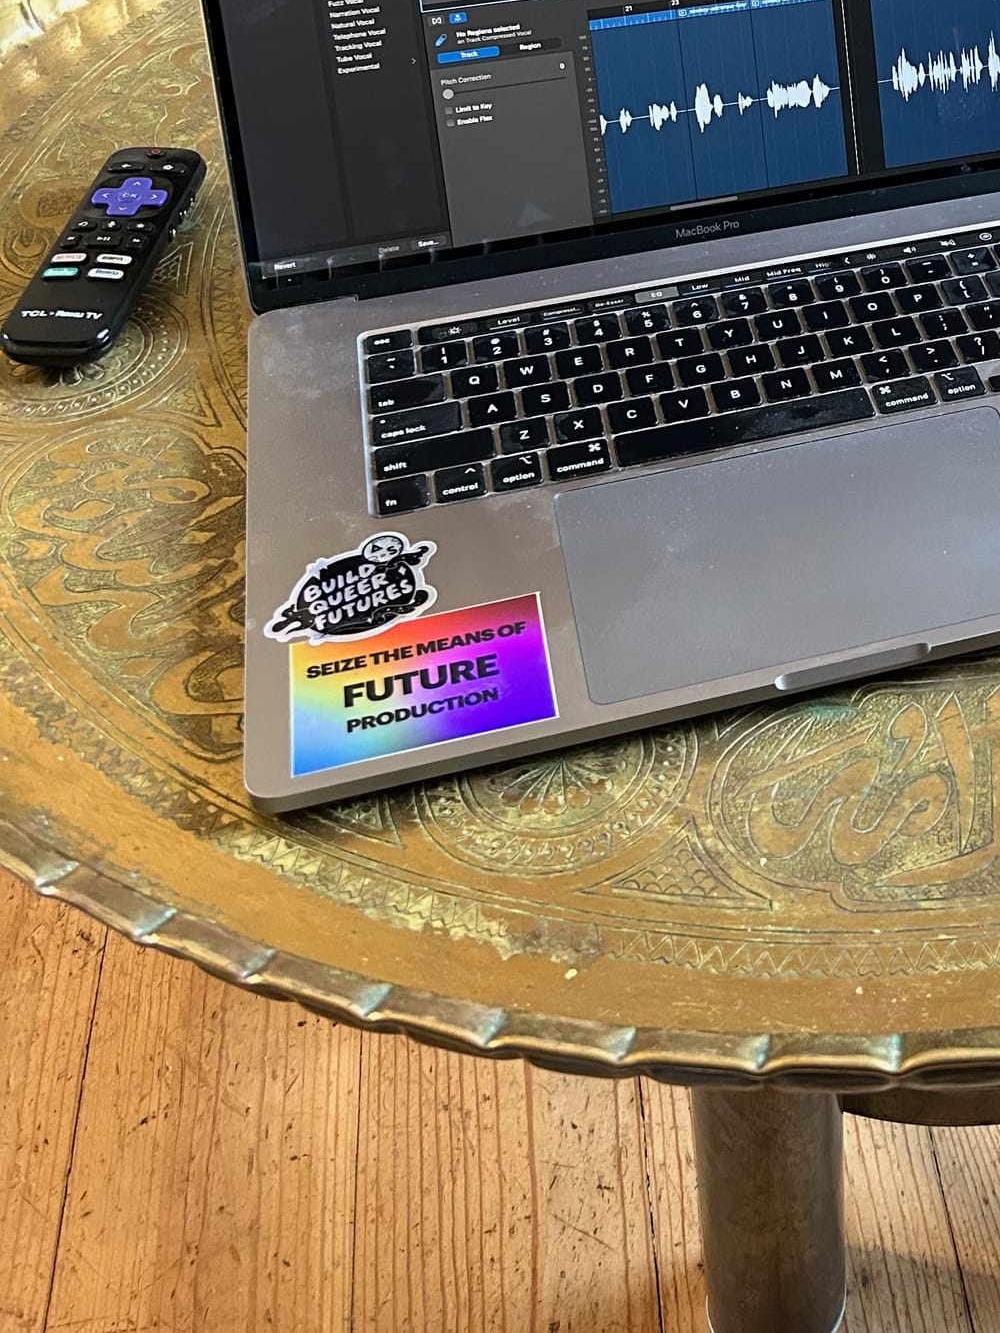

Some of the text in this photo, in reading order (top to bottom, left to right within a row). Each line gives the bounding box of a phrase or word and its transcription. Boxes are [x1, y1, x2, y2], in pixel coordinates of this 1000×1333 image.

[328, 0, 344, 8] Fuzz
[329, 6, 380, 19] Narration Vocal
[331, 18, 375, 30] Natural Vocal
[333, 28, 386, 41] Telephone Vocal
[456, 24, 520, 38] No Regions selected
[466, 35, 481, 43] Track
[482, 32, 516, 42] Compressed
[517, 29, 532, 37] Vocal
[334, 40, 382, 52] Tracking Vocal
[519, 42, 542, 52] Region
[336, 53, 373, 63] Tube Vocal
[460, 49, 478, 58] Track
[337, 63, 380, 75] Experimental
[440, 73, 491, 86] Pitch Correction
[455, 105, 472, 113] Limit
[480, 102, 493, 111] Key
[457, 115, 493, 126] Enable Flex
[675, 220, 740, 239] MacBook Pro
[378, 245, 400, 253] Delete
[274, 262, 297, 271] Revert
[783, 266, 801, 276] Freq
[734, 275, 750, 283] Mid
[881, 276, 890, 284] 0
[691, 283, 709, 291] Low
[834, 285, 844, 293] 9
[788, 293, 798, 301] 8
[913, 294, 923, 303] P
[741, 302, 749, 310] 7
[867, 302, 878, 311] O
[21, 310, 48, 318] TCL
[86, 312, 103, 320] TV
[692, 311, 702, 319] 6
[823, 311, 828, 320] I
[497, 317, 520, 325] Level
[644, 319, 653, 328] 5
[772, 320, 783, 329] U
[594, 328, 604, 336] 4
[724, 329, 734, 338] Y
[891, 327, 901, 336] L
[544, 337, 553, 346] 3
[675, 338, 684, 347] T
[843, 336, 854, 346] K
[492, 346, 502, 355] 2
[624, 348, 635, 356] R
[797, 346, 805, 355] J
[441, 356, 448, 364] 1
[574, 357, 584, 366] E
[745, 355, 757, 364] H
[519, 366, 534, 376] W
[695, 364, 707, 374] G
[645, 374, 654, 384] F
[829, 370, 843, 380] M
[468, 375, 481, 386] Q
[780, 379, 793, 389] N
[593, 384, 604, 393] D
[947, 384, 976, 395] option
[540, 394, 551, 403] S
[730, 389, 741, 399] B
[378, 398, 395, 407] tab
[678, 399, 689, 409] V
[885, 393, 929, 407] command
[487, 403, 499, 413] A
[626, 409, 638, 419] C
[573, 420, 585, 430] X
[381, 424, 427, 439] caps lock
[519, 429, 530, 440] Z
[383, 461, 408, 472] shift
[556, 458, 605, 473] command
[502, 471, 535, 484] option
[442, 482, 479, 495] control
[384, 498, 398, 507] fn
[303, 563, 377, 602] BUILD
[308, 574, 389, 615] QUEER
[314, 579, 413, 631] FUTURES
[306, 621, 526, 678] SEIZE THE MEANS OF
[343, 654, 500, 708] FUTURE
[347, 687, 499, 733] PRODUCTION
